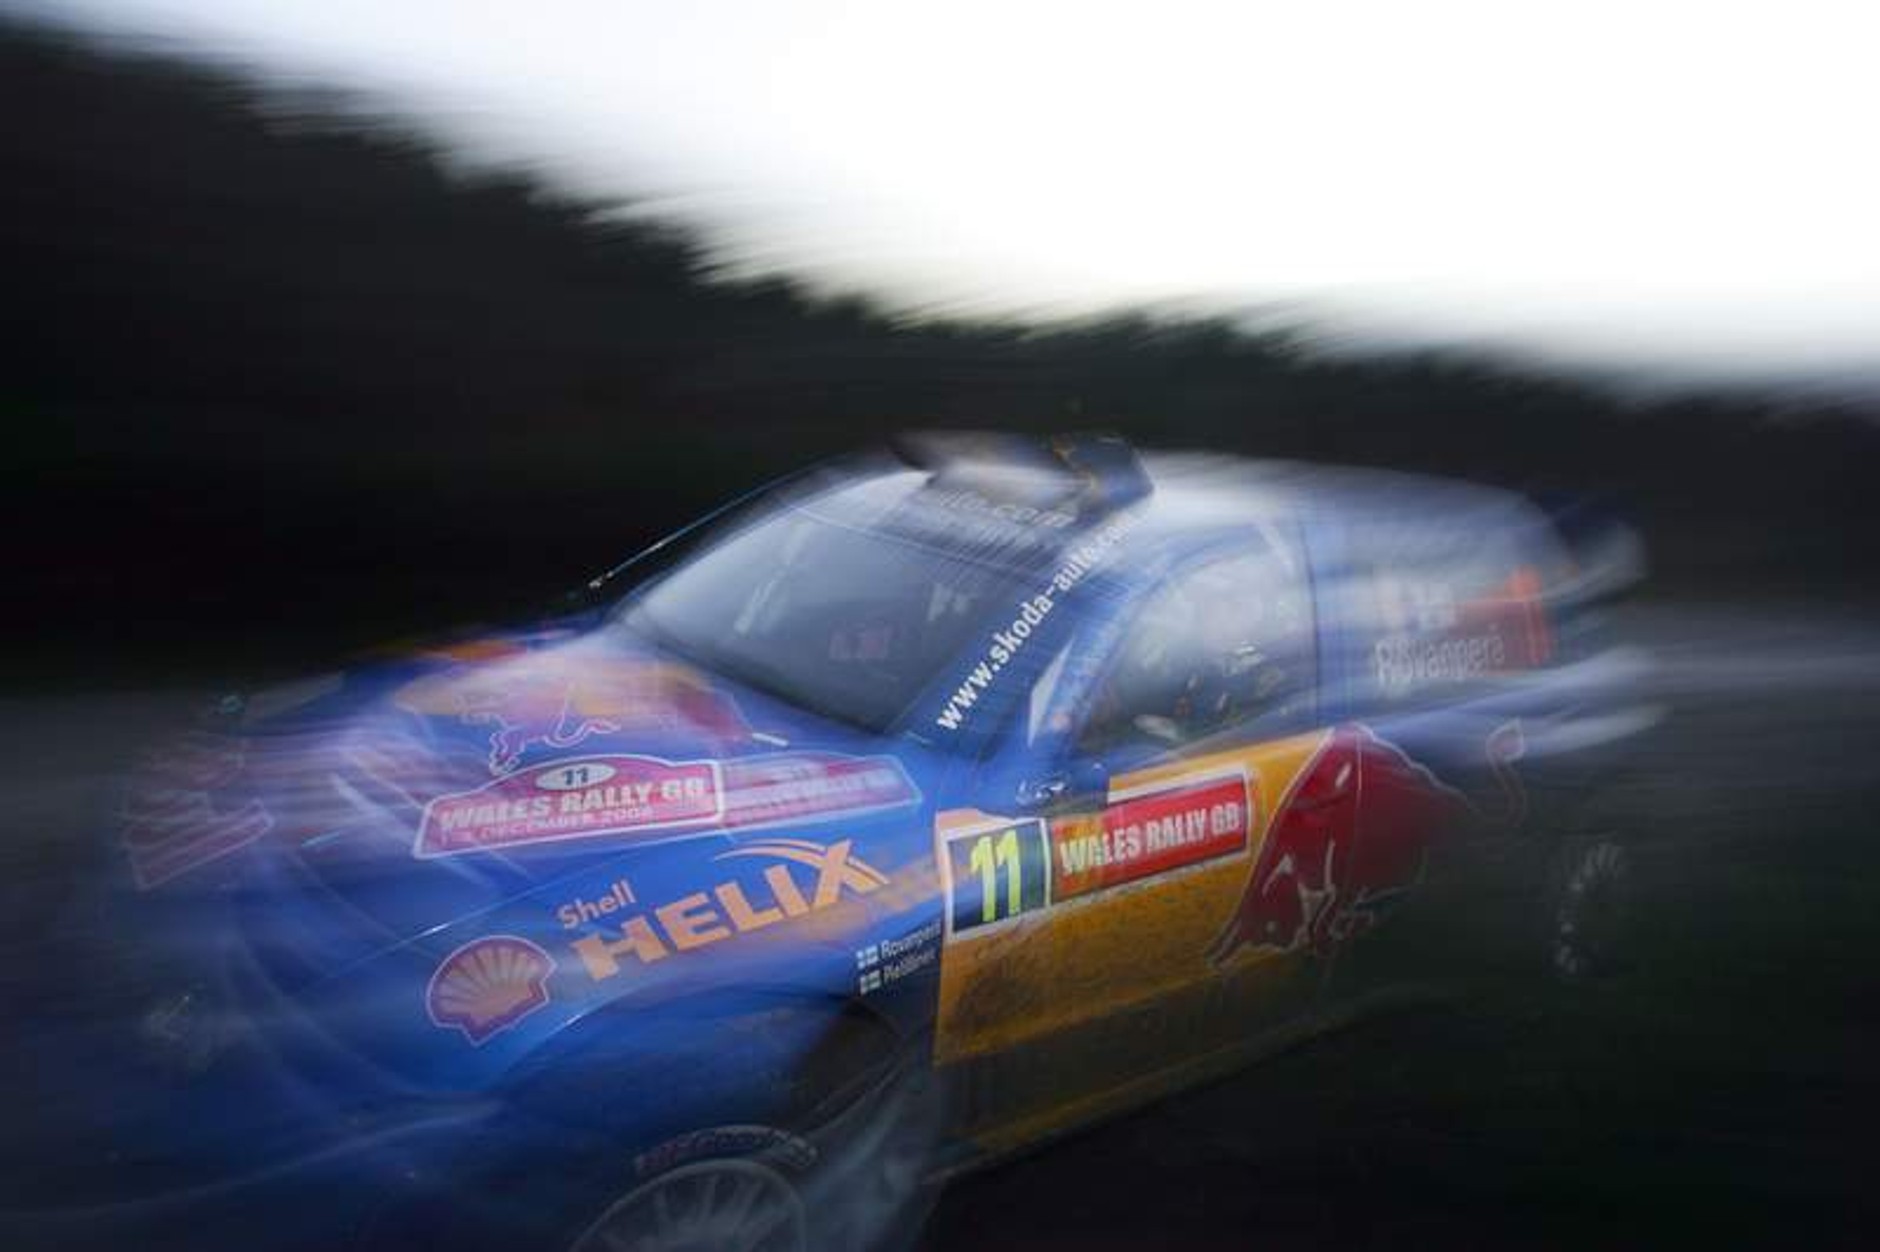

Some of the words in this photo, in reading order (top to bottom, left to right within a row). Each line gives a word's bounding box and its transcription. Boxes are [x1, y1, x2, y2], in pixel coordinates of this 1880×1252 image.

[440, 796, 551, 829] WALES
[562, 782, 653, 813] RALLY
[565, 768, 589, 787] 11
[1060, 829, 1141, 874] WALES
[1146, 807, 1206, 853] RALLY
[1210, 801, 1241, 836] GB
[558, 880, 635, 929] Shell
[970, 828, 1021, 923] 11
[573, 838, 888, 981] HELIX
